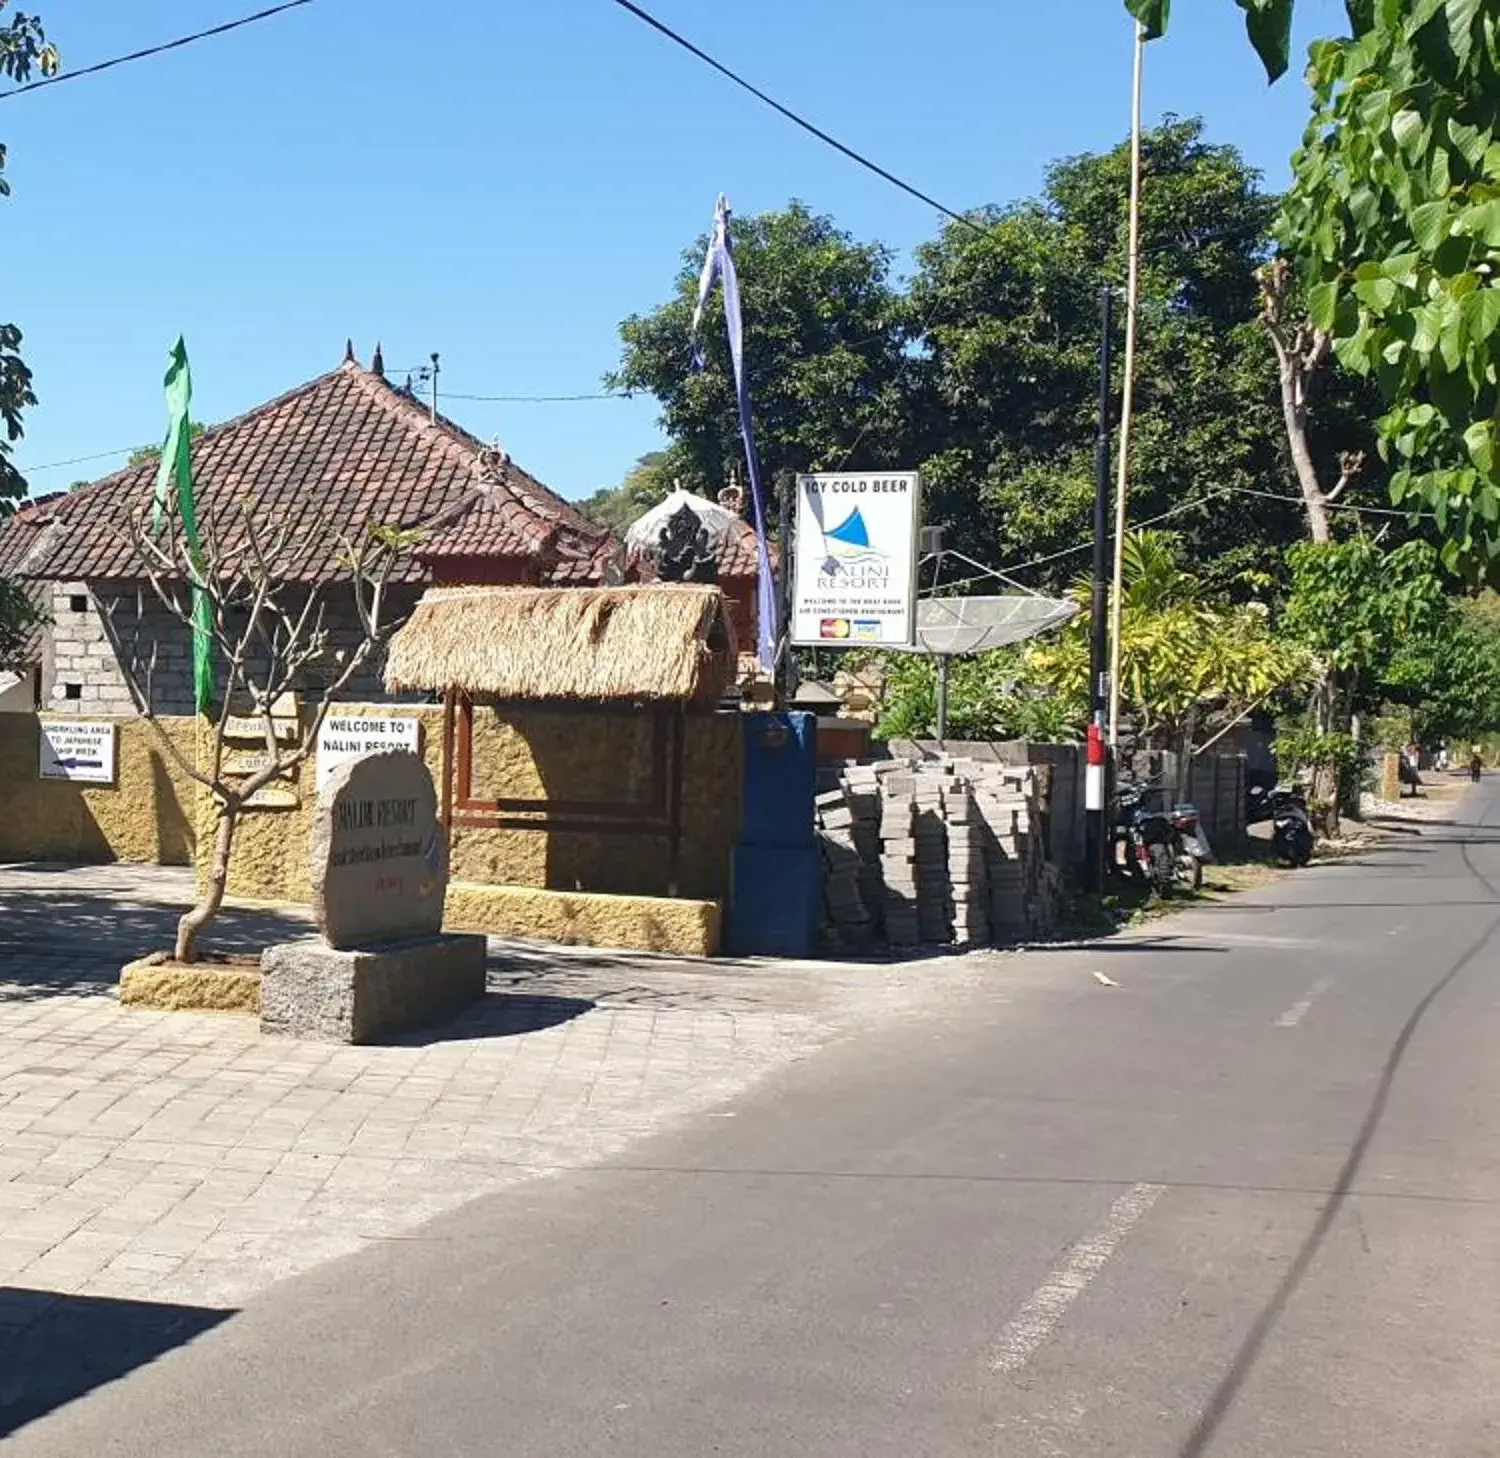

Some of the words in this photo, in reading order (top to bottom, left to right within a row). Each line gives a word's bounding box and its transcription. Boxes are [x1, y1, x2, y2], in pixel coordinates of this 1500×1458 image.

[806, 481, 827, 493] ICY
[832, 481, 867, 492] COLD
[873, 480, 907, 492] BEER
[817, 578, 888, 588] RESORT
[329, 720, 386, 733] WELCOME
[390, 722, 405, 732] TO
[51, 735, 61, 743] TO
[323, 740, 361, 753] NALINI
